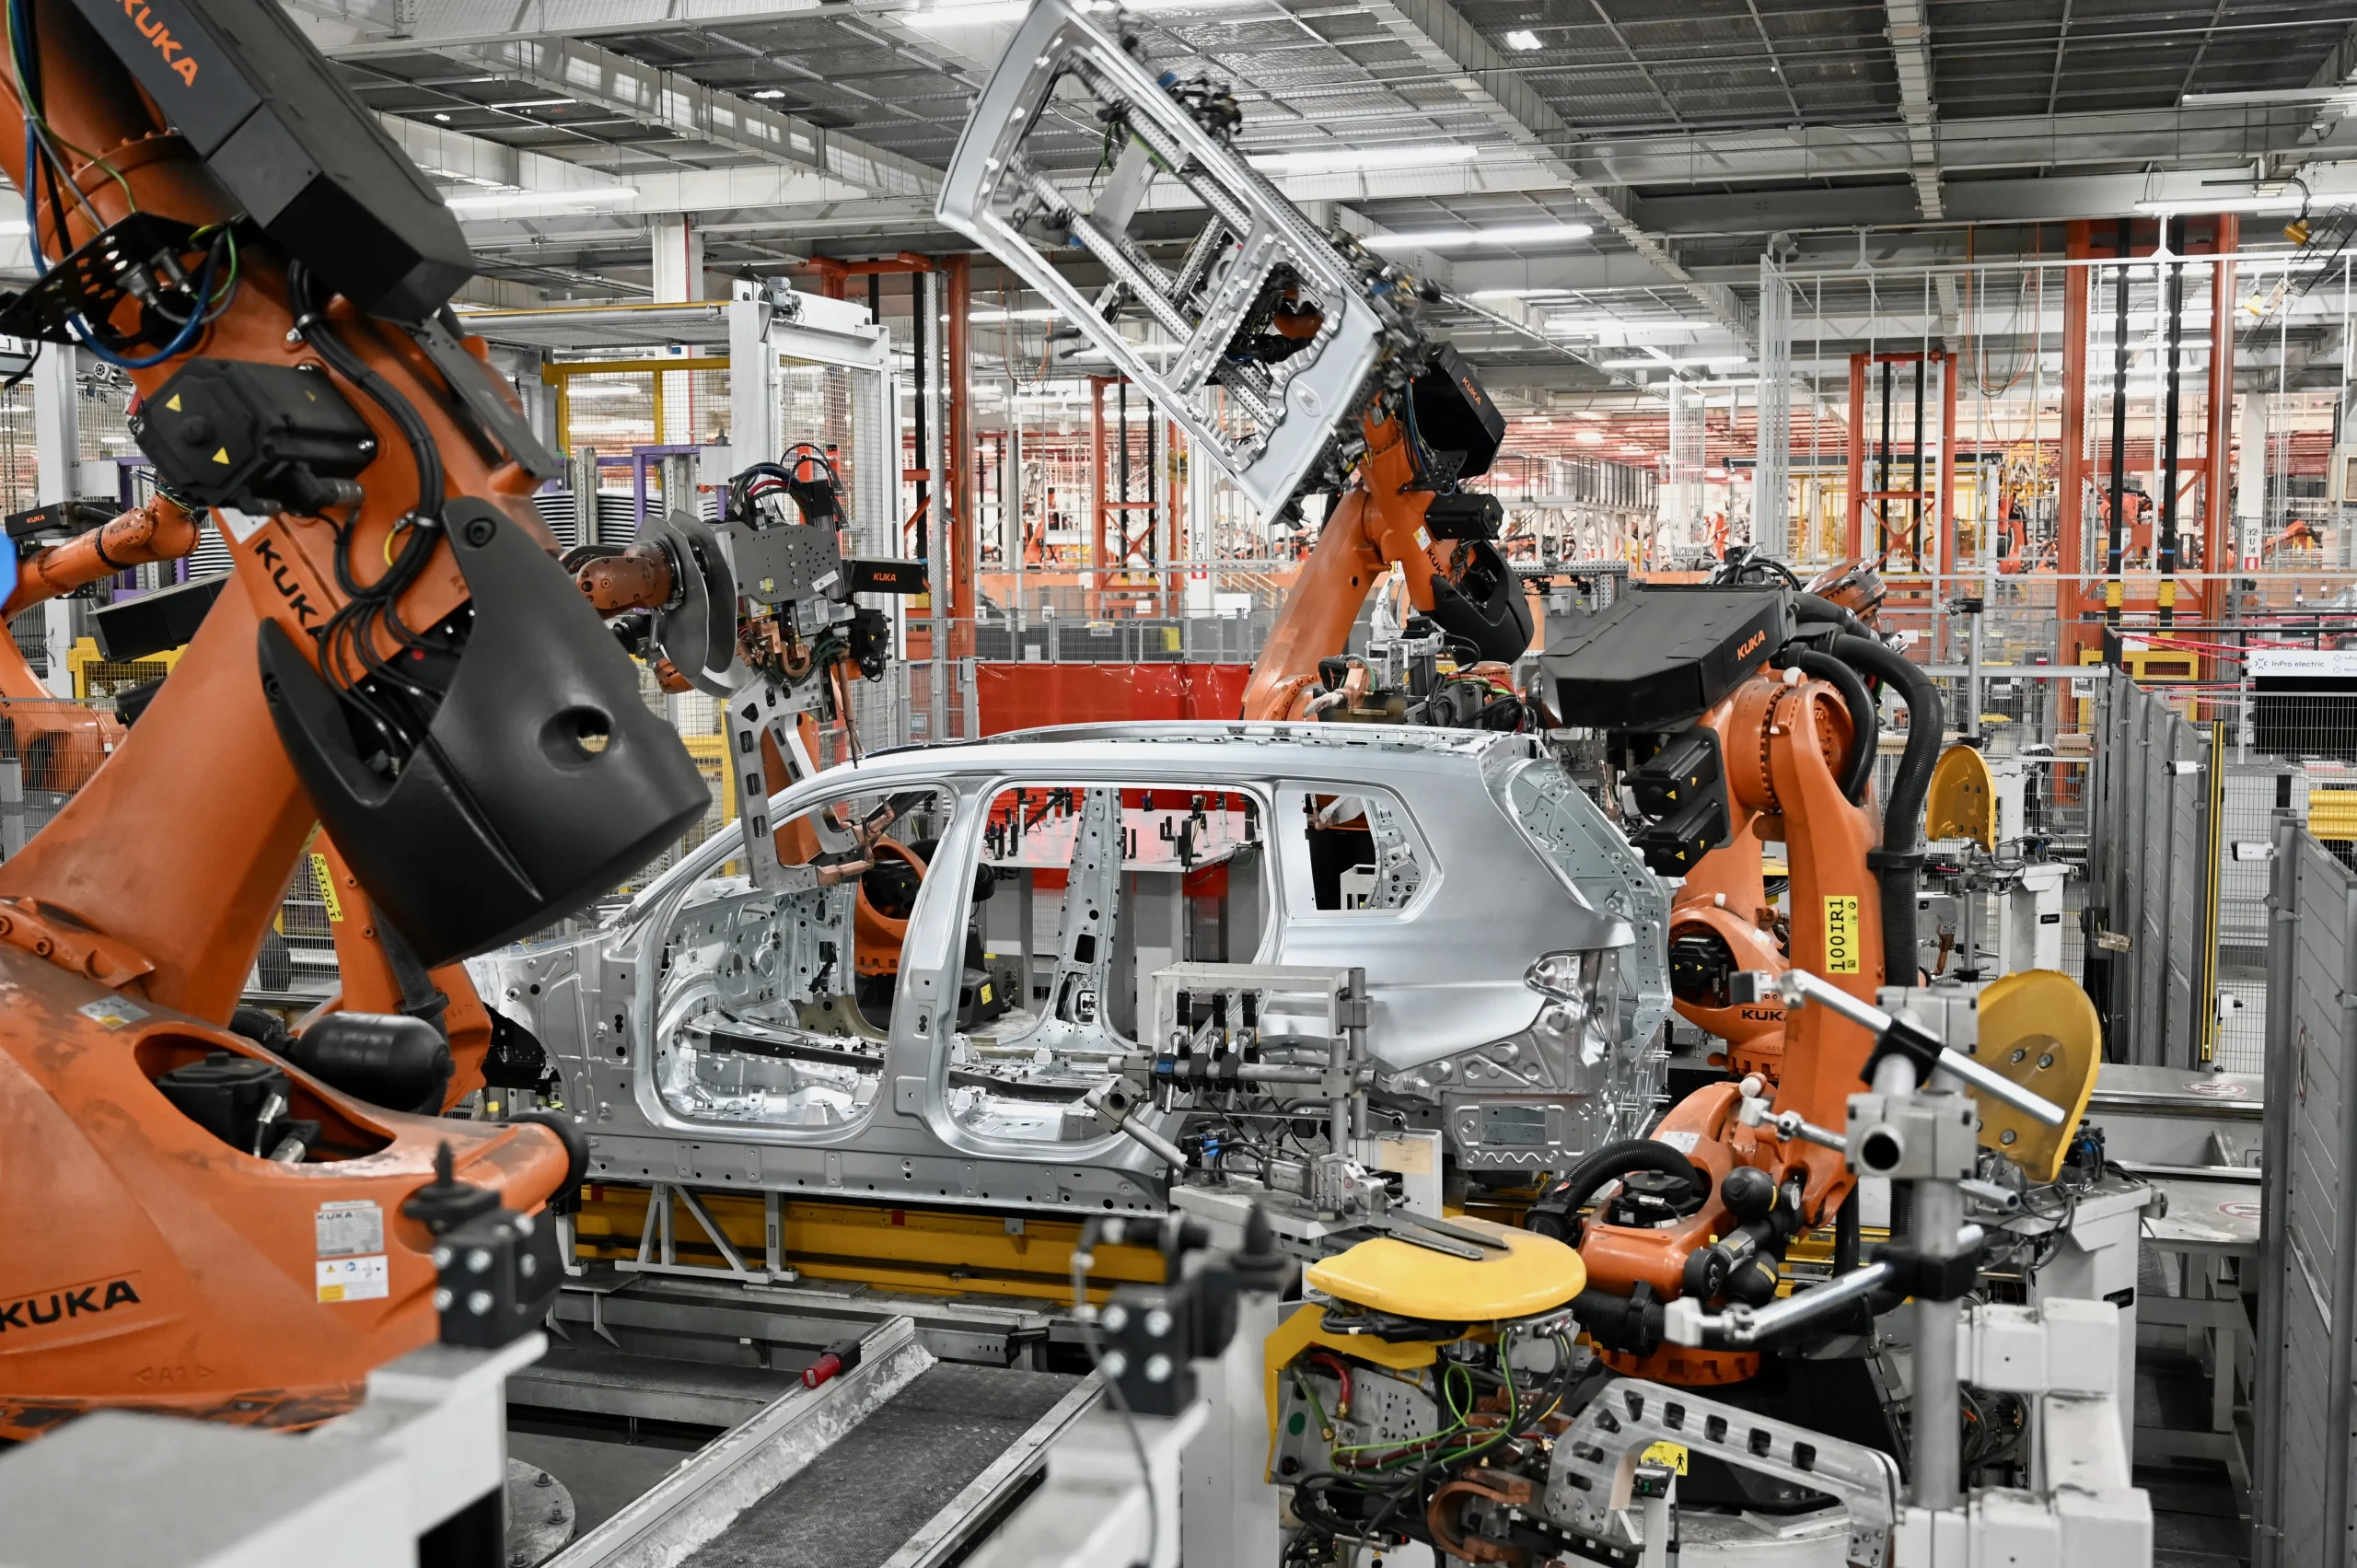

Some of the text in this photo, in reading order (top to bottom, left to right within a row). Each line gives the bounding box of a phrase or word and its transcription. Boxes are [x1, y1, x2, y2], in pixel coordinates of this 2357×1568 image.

[1462, 377, 1481, 405] KUKA
[26, 514, 46, 524] KUKA
[109, 521, 133, 536] KUKA
[873, 572, 897, 582] KUKA
[1736, 629, 1766, 661] KUKA
[1829, 899, 1846, 971] 100IR1
[1742, 1009, 1786, 1022] KUK
[317, 1211, 354, 1220] KUKA
[0, 1279, 141, 1332] KUKA
